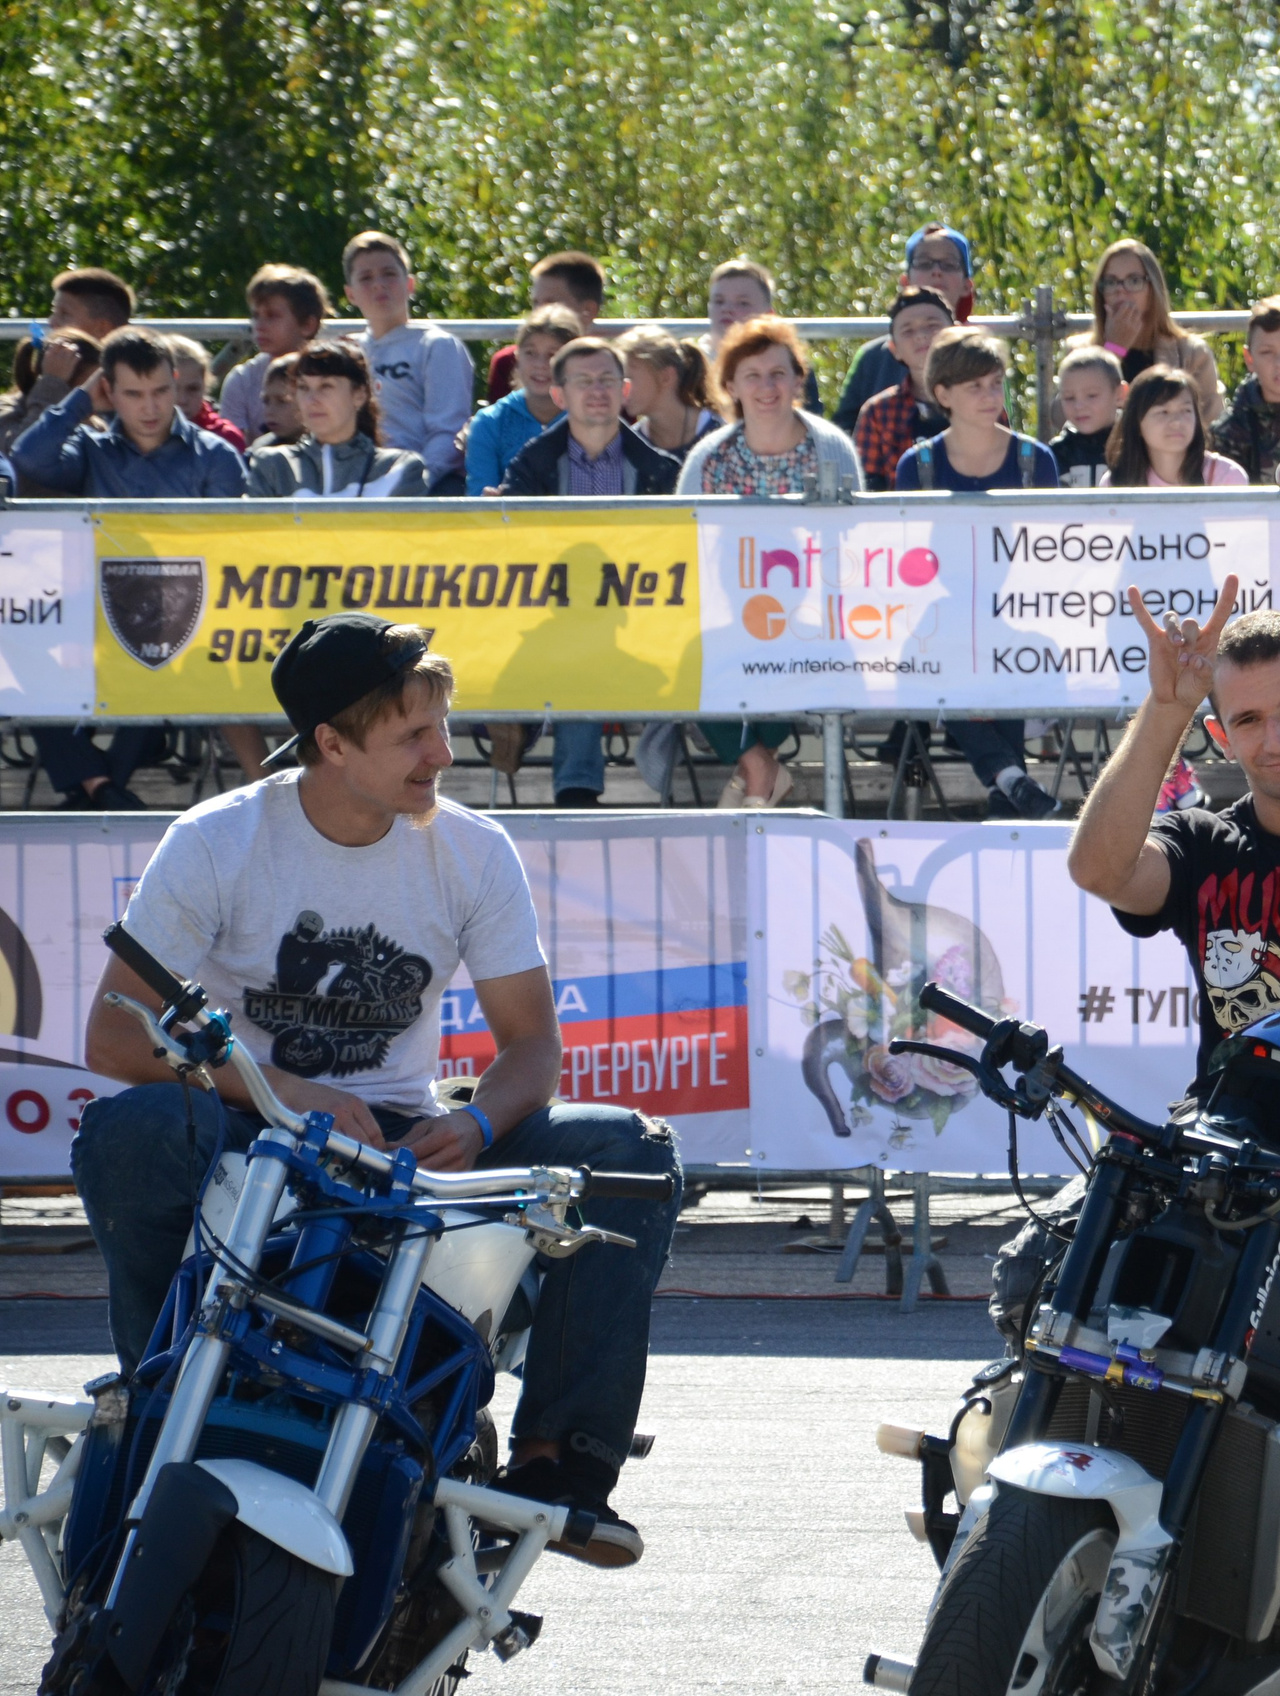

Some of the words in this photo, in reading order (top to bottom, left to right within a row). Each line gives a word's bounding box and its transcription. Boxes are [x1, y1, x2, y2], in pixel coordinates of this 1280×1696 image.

[992, 524, 1226, 563] Мебельно-
[215, 562, 570, 609] МОТОШКОЛА
[595, 562, 687, 607] №1
[742, 657, 941, 675] www.interio-mebel.ru
[992, 646, 1147, 675] компле
